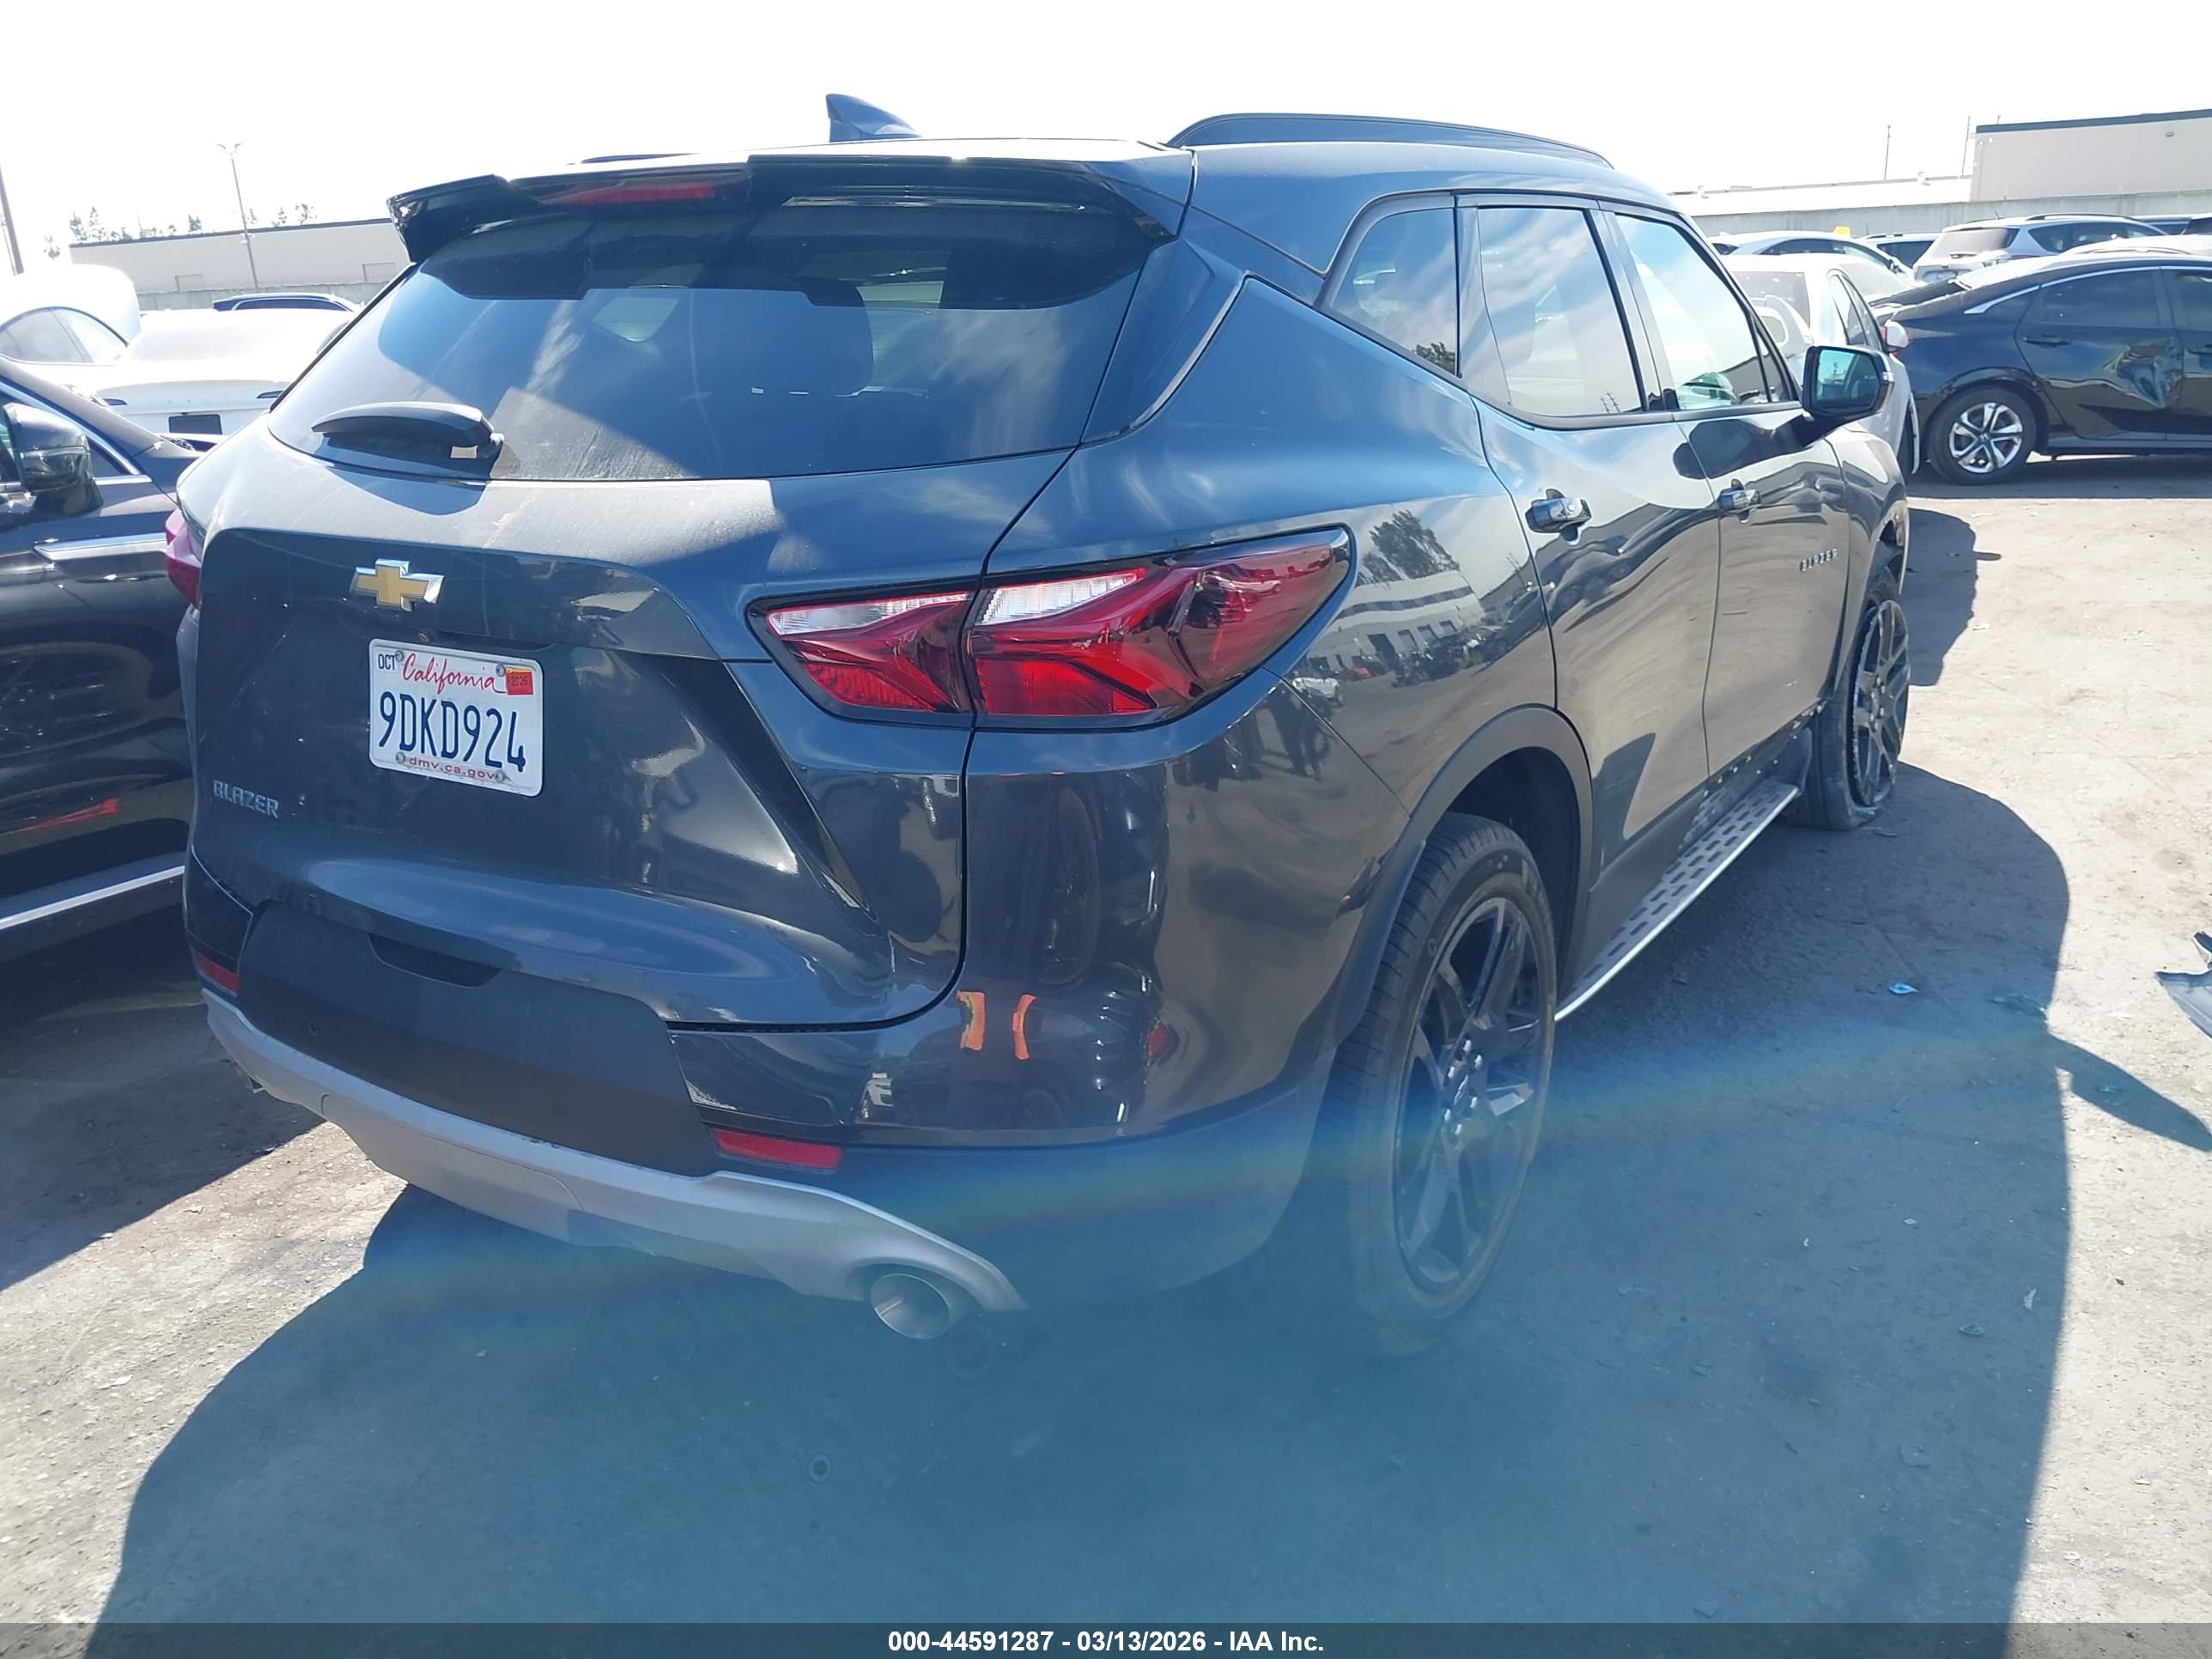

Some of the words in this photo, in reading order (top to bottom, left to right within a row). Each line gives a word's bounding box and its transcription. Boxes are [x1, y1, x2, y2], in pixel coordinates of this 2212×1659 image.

[378, 653, 398, 671] OCT
[402, 653, 507, 695] California
[378, 690, 526, 773] 9DKD924
[409, 756, 496, 781] dmv.ca.gov
[213, 779, 280, 819] BLAZER
